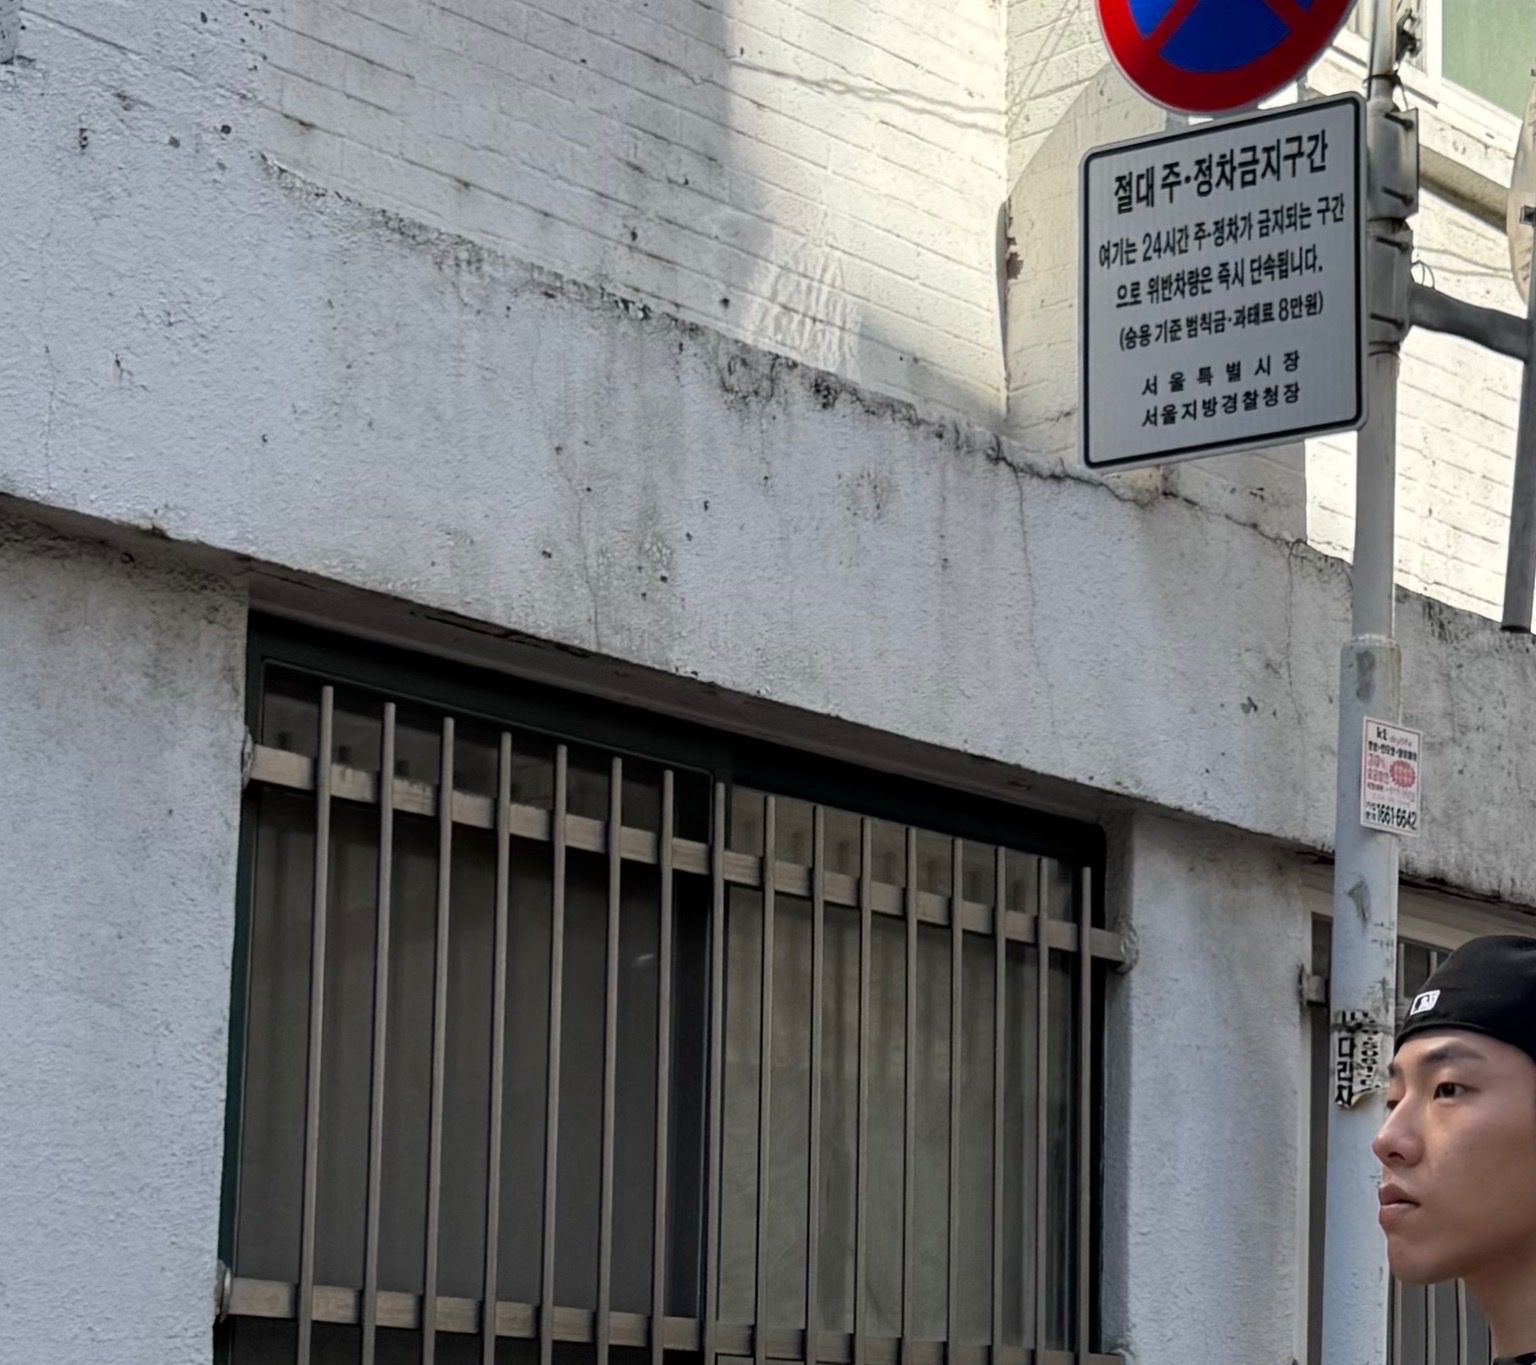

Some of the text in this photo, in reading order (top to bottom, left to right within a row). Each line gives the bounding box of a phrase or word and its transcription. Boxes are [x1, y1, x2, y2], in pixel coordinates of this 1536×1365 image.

[1113, 129, 1329, 214] 절대 주·정차금지구간
[1098, 192, 1346, 269] 여기는 24시간 주·정차가 금지되는 구간
[1115, 243, 1323, 308] 으로 위반차량은 즉시 단속됩니다.
[1119, 290, 1324, 351] (승용 기준 범칙금·과태료 8만원)
[1141, 381, 1300, 427] 서울지방경찰청장
